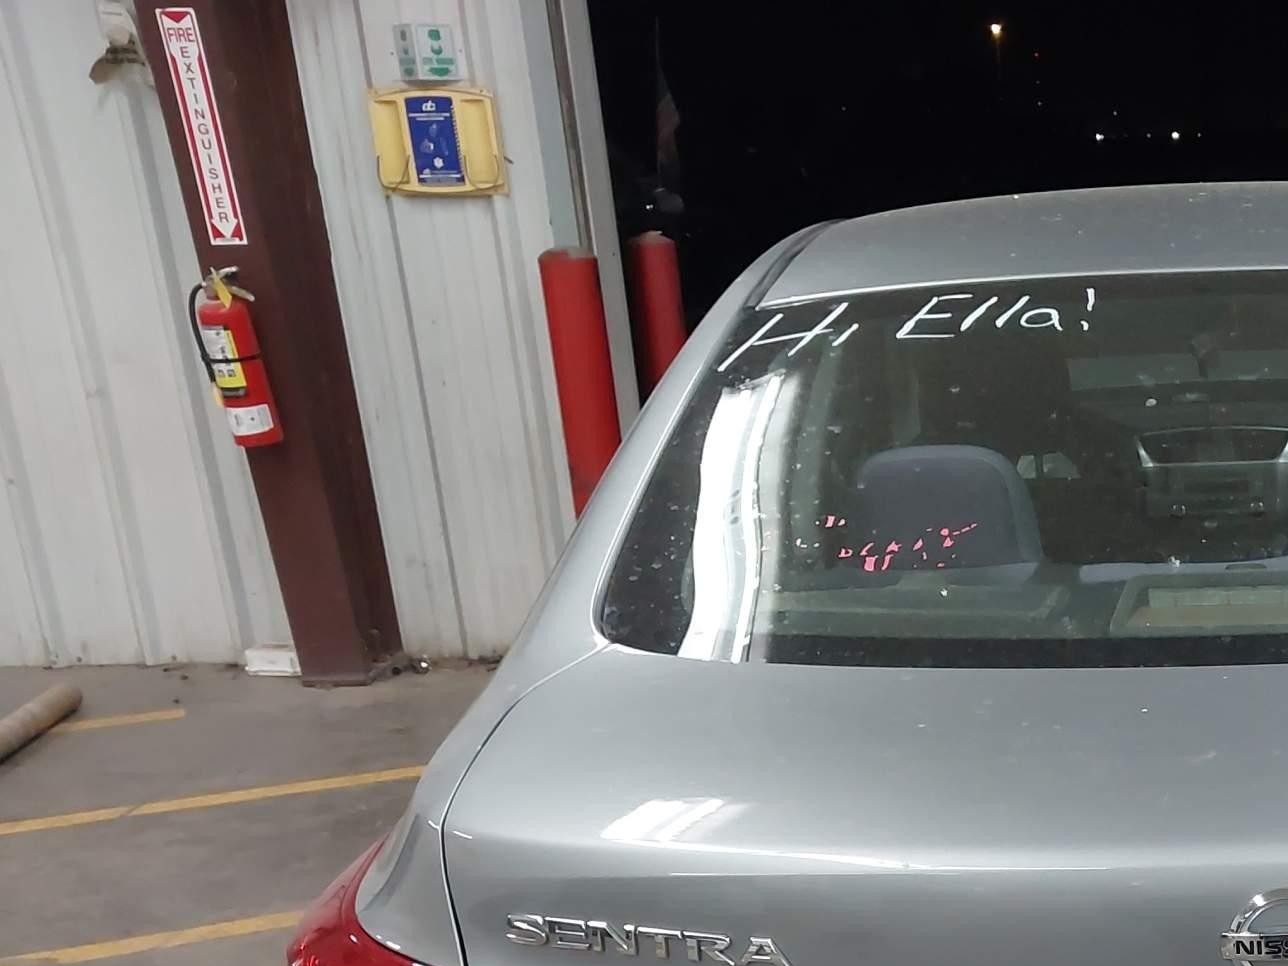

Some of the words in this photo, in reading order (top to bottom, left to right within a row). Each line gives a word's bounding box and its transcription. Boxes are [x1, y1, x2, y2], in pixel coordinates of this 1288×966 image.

[167, 27, 195, 43] FIRE
[179, 46, 231, 223] EXTINGUISHER
[896, 288, 1095, 339] Ella!
